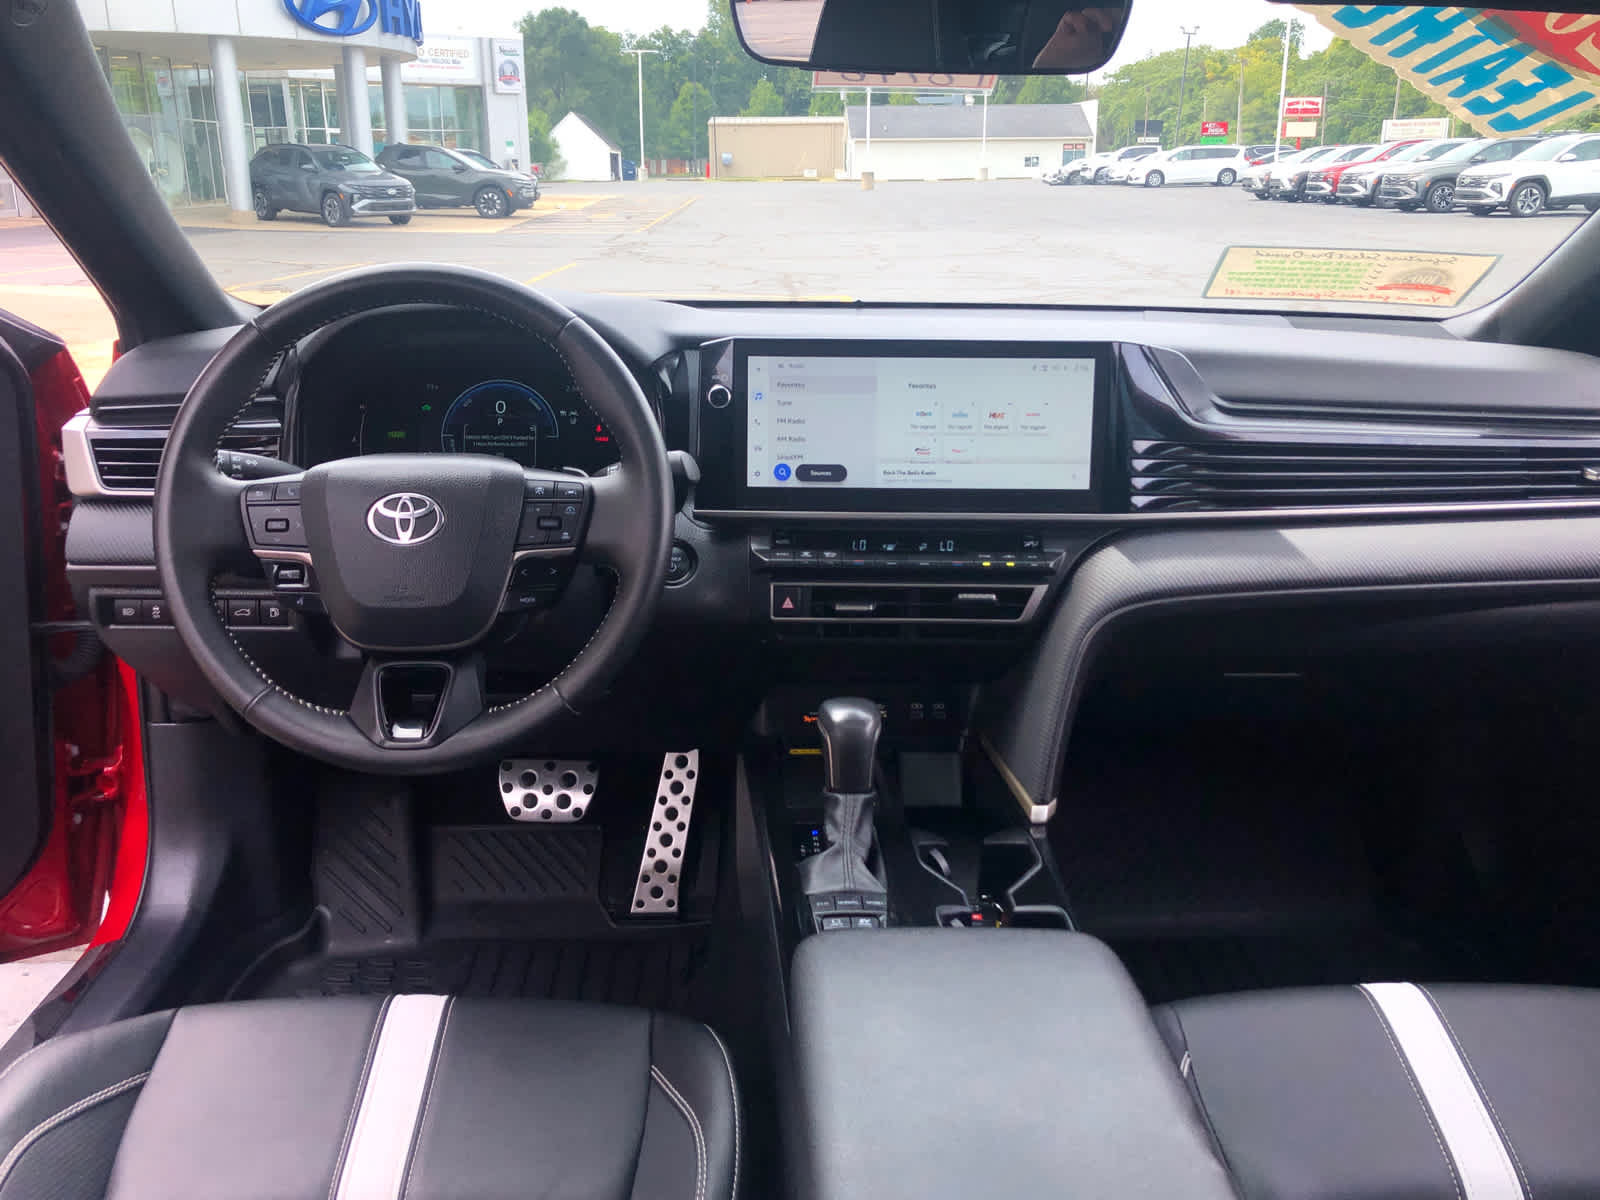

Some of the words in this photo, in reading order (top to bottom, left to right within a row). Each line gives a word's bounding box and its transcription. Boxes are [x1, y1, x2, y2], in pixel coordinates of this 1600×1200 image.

[495, 400, 506, 414] 0
[497, 417, 503, 425] P
[810, 469, 832, 477] Sources
